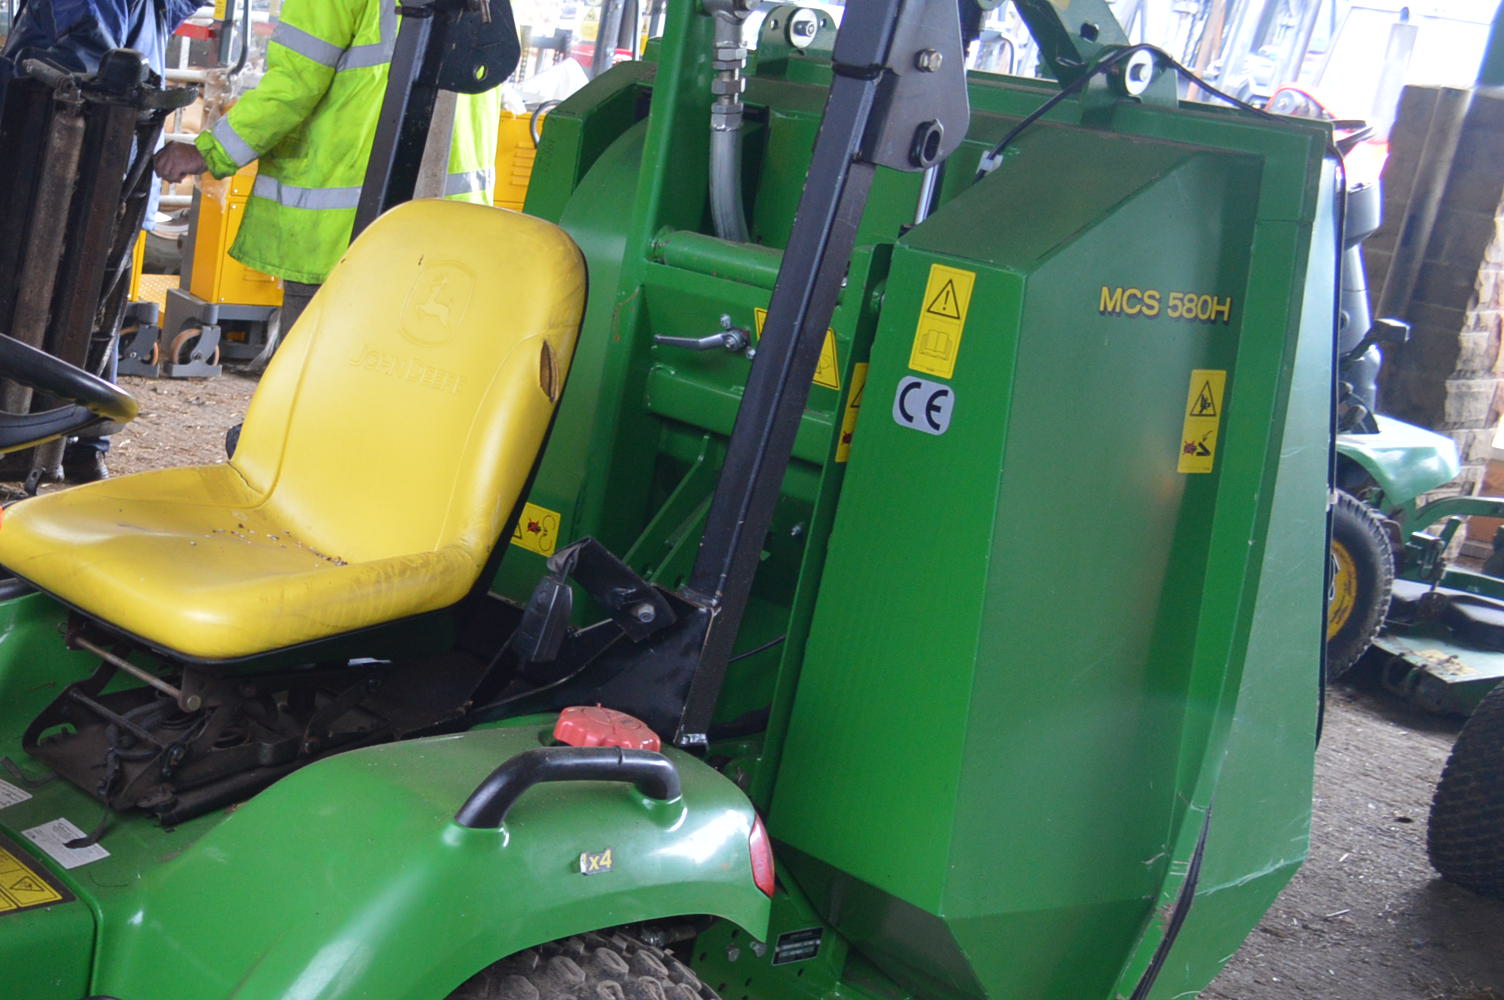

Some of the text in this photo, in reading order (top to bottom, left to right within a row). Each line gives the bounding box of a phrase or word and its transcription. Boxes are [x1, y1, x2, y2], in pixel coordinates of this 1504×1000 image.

[1098, 285, 1233, 323] MCS 580H
[899, 381, 950, 431] CE
